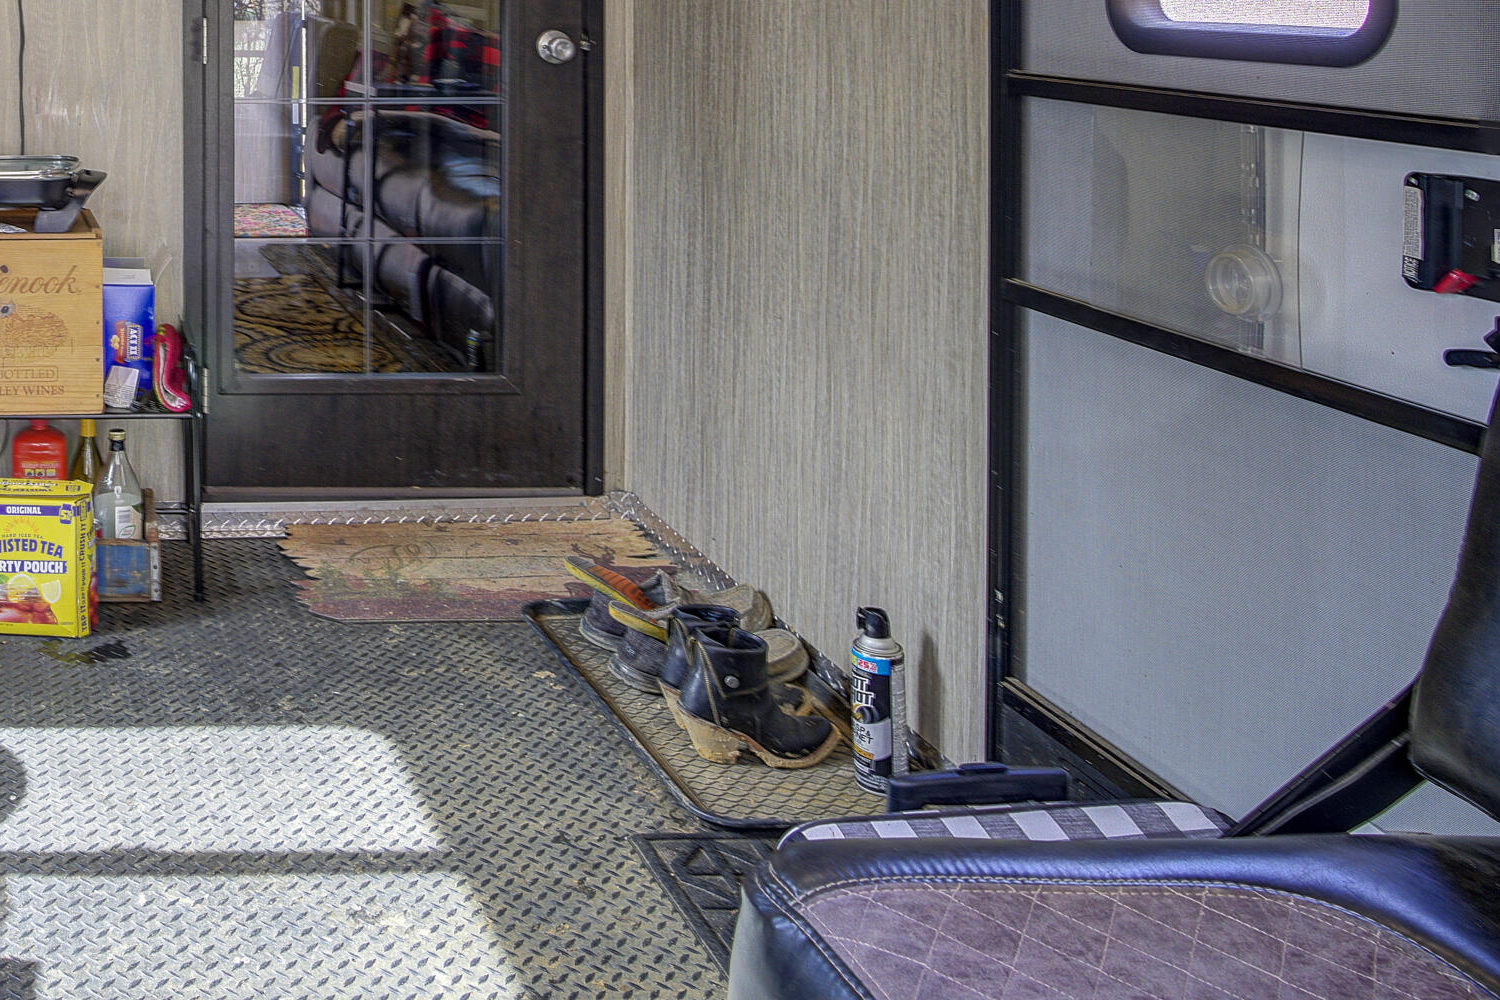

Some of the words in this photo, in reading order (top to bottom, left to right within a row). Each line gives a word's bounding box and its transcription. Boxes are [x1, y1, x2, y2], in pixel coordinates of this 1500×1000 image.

[22, 385, 65, 395] WINES
[6, 505, 42, 515] ORIGINAL
[40, 540, 64, 559] TEA
[23, 560, 64, 574] POUCH
